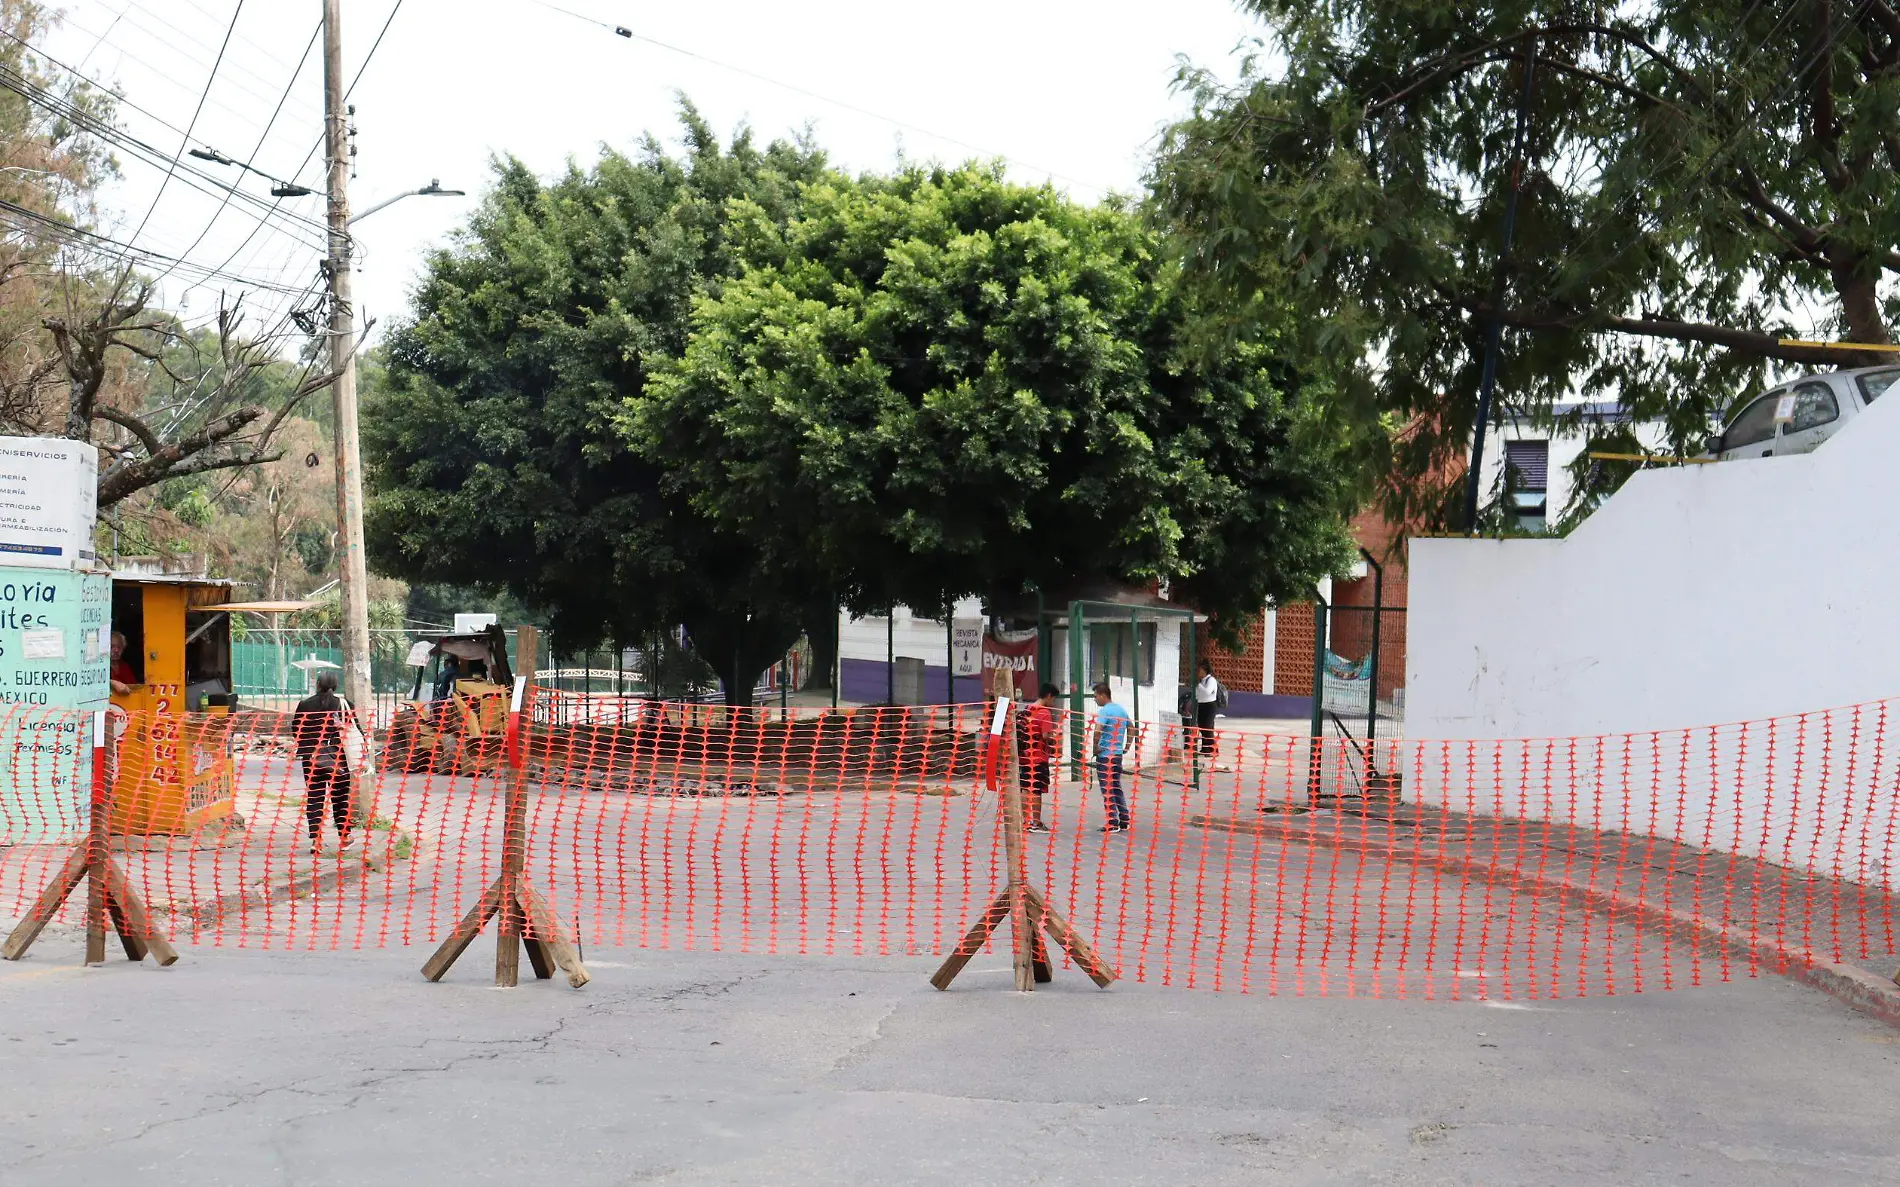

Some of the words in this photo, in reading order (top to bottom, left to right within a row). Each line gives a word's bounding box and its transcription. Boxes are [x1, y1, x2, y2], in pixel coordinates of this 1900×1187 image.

[0, 581, 56, 603] oria
[956, 629, 978, 637] REVISTA
[983, 652, 1035, 672] ENTRADA
[15, 670, 78, 686] GUERRERO
[149, 684, 179, 697] 777
[156, 698, 172, 718] 2
[151, 720, 179, 742] 62
